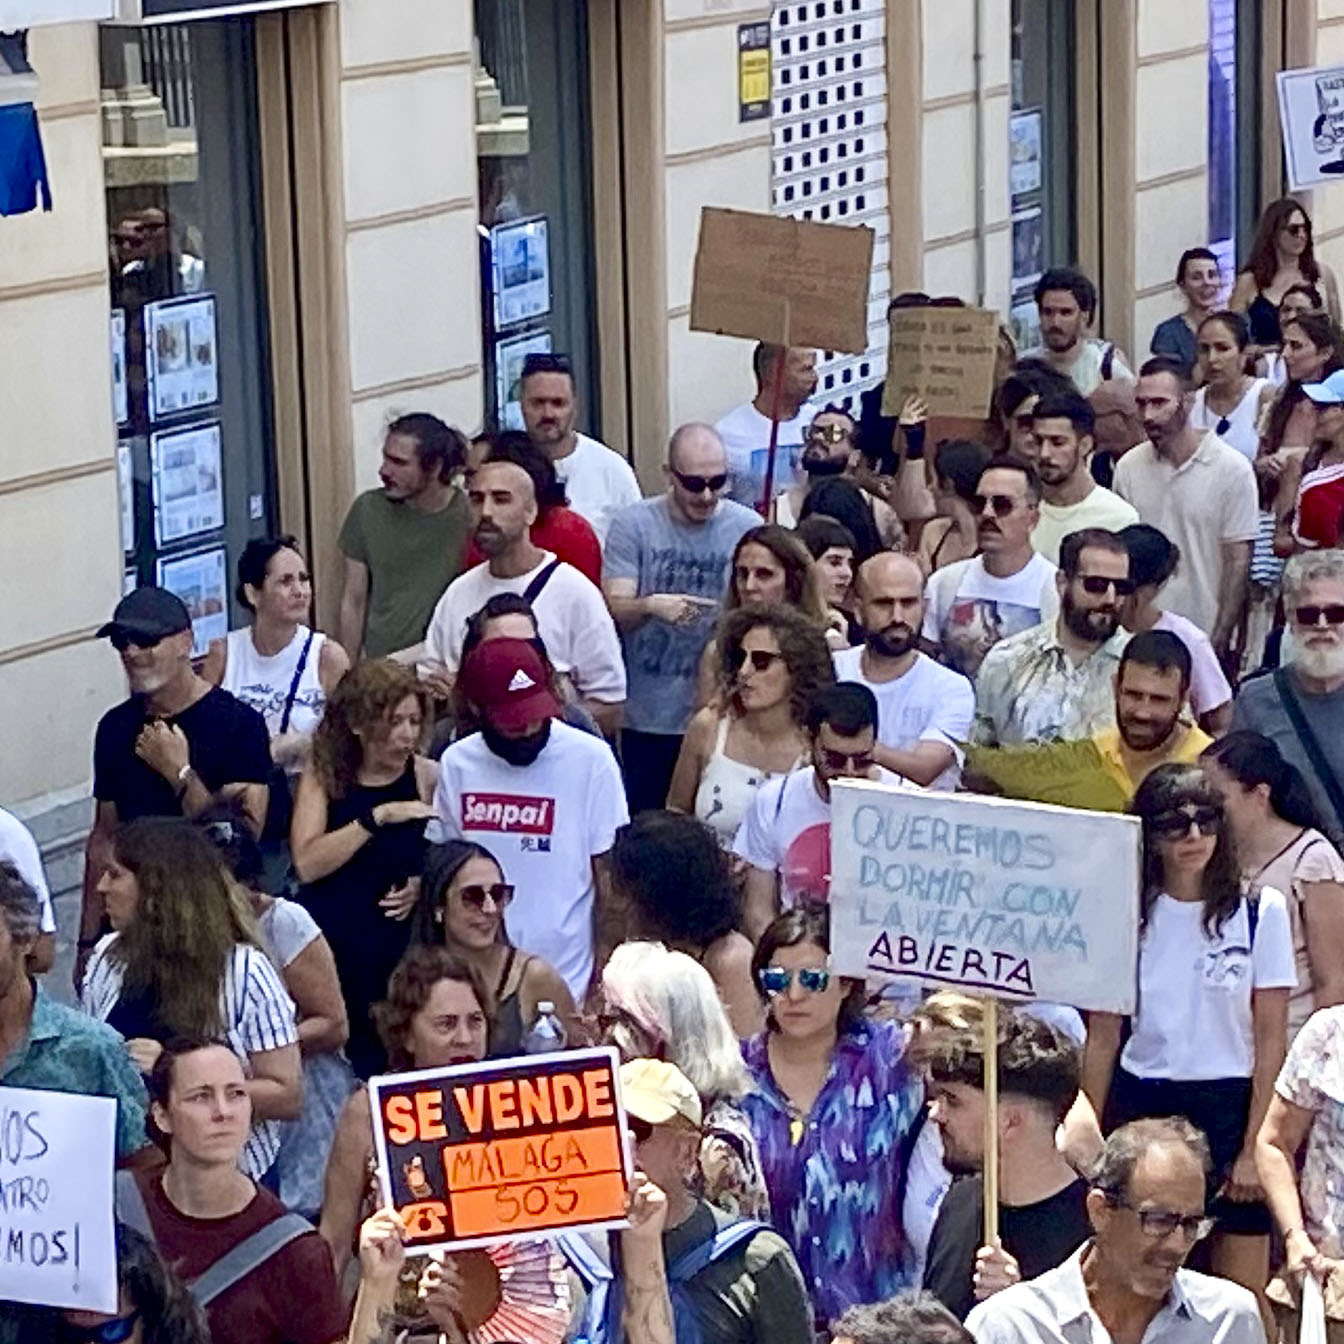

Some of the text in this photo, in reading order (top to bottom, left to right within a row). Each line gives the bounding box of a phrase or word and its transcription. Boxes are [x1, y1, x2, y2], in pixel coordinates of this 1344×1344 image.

[852, 804, 1055, 870] QUEREMOS
[1002, 881, 1081, 917] CON
[859, 899, 1087, 961] LA VENTANA
[868, 931, 1034, 990] ABIERTA
[385, 1068, 615, 1145] SE VENDE
[494, 1180, 579, 1224] SOS
